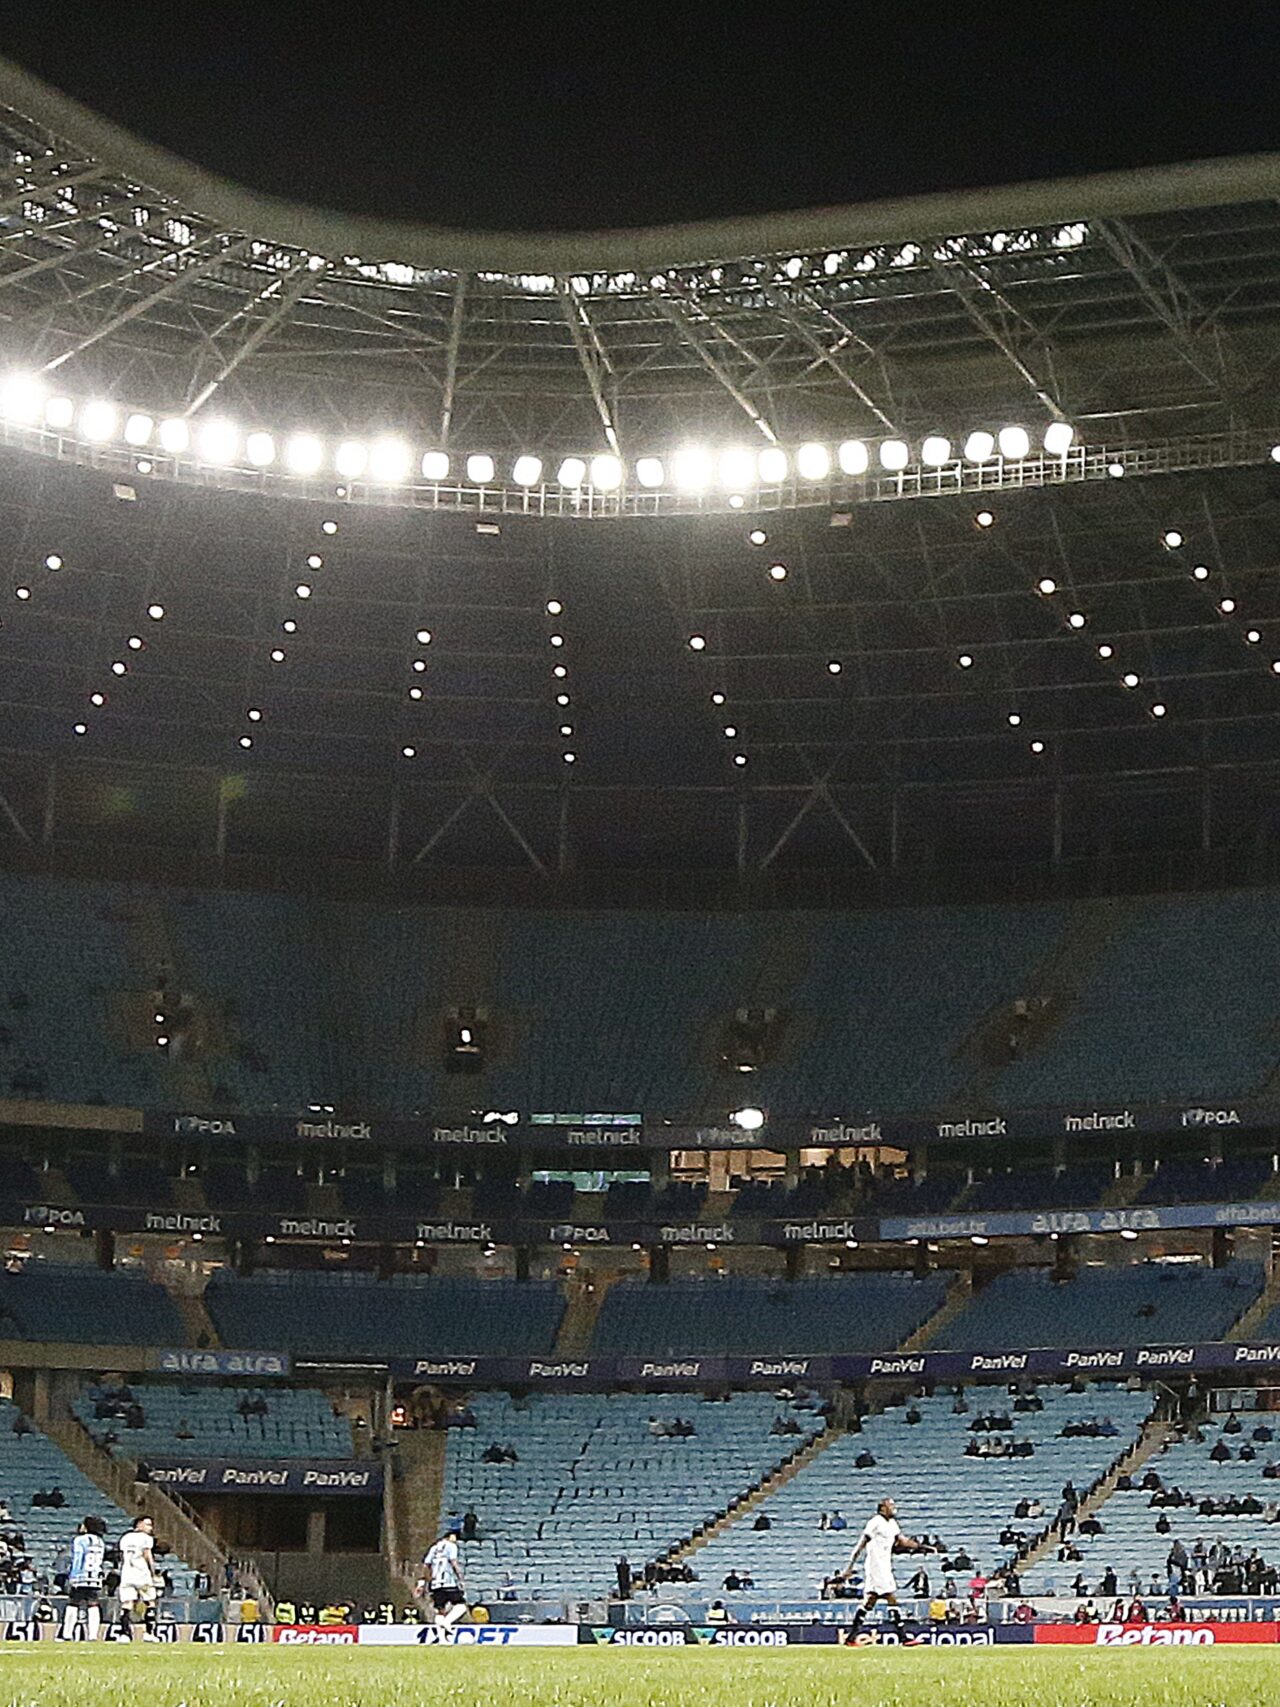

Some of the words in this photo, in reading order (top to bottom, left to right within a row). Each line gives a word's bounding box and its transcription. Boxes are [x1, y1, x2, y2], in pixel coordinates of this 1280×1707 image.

[1204, 1110, 1240, 1124] POA
[198, 1119, 236, 1135] POA
[48, 1209, 85, 1225] POA
[572, 1227, 609, 1242] POA
[148, 1469, 207, 1484] anVel
[12, 1622, 35, 1641] 51
[198, 1625, 217, 1642] 51
[242, 1625, 261, 1642] 51
[614, 1631, 686, 1646] SICOOB
[715, 1631, 788, 1646] SICOOB
[1096, 1625, 1215, 1645] Betano
